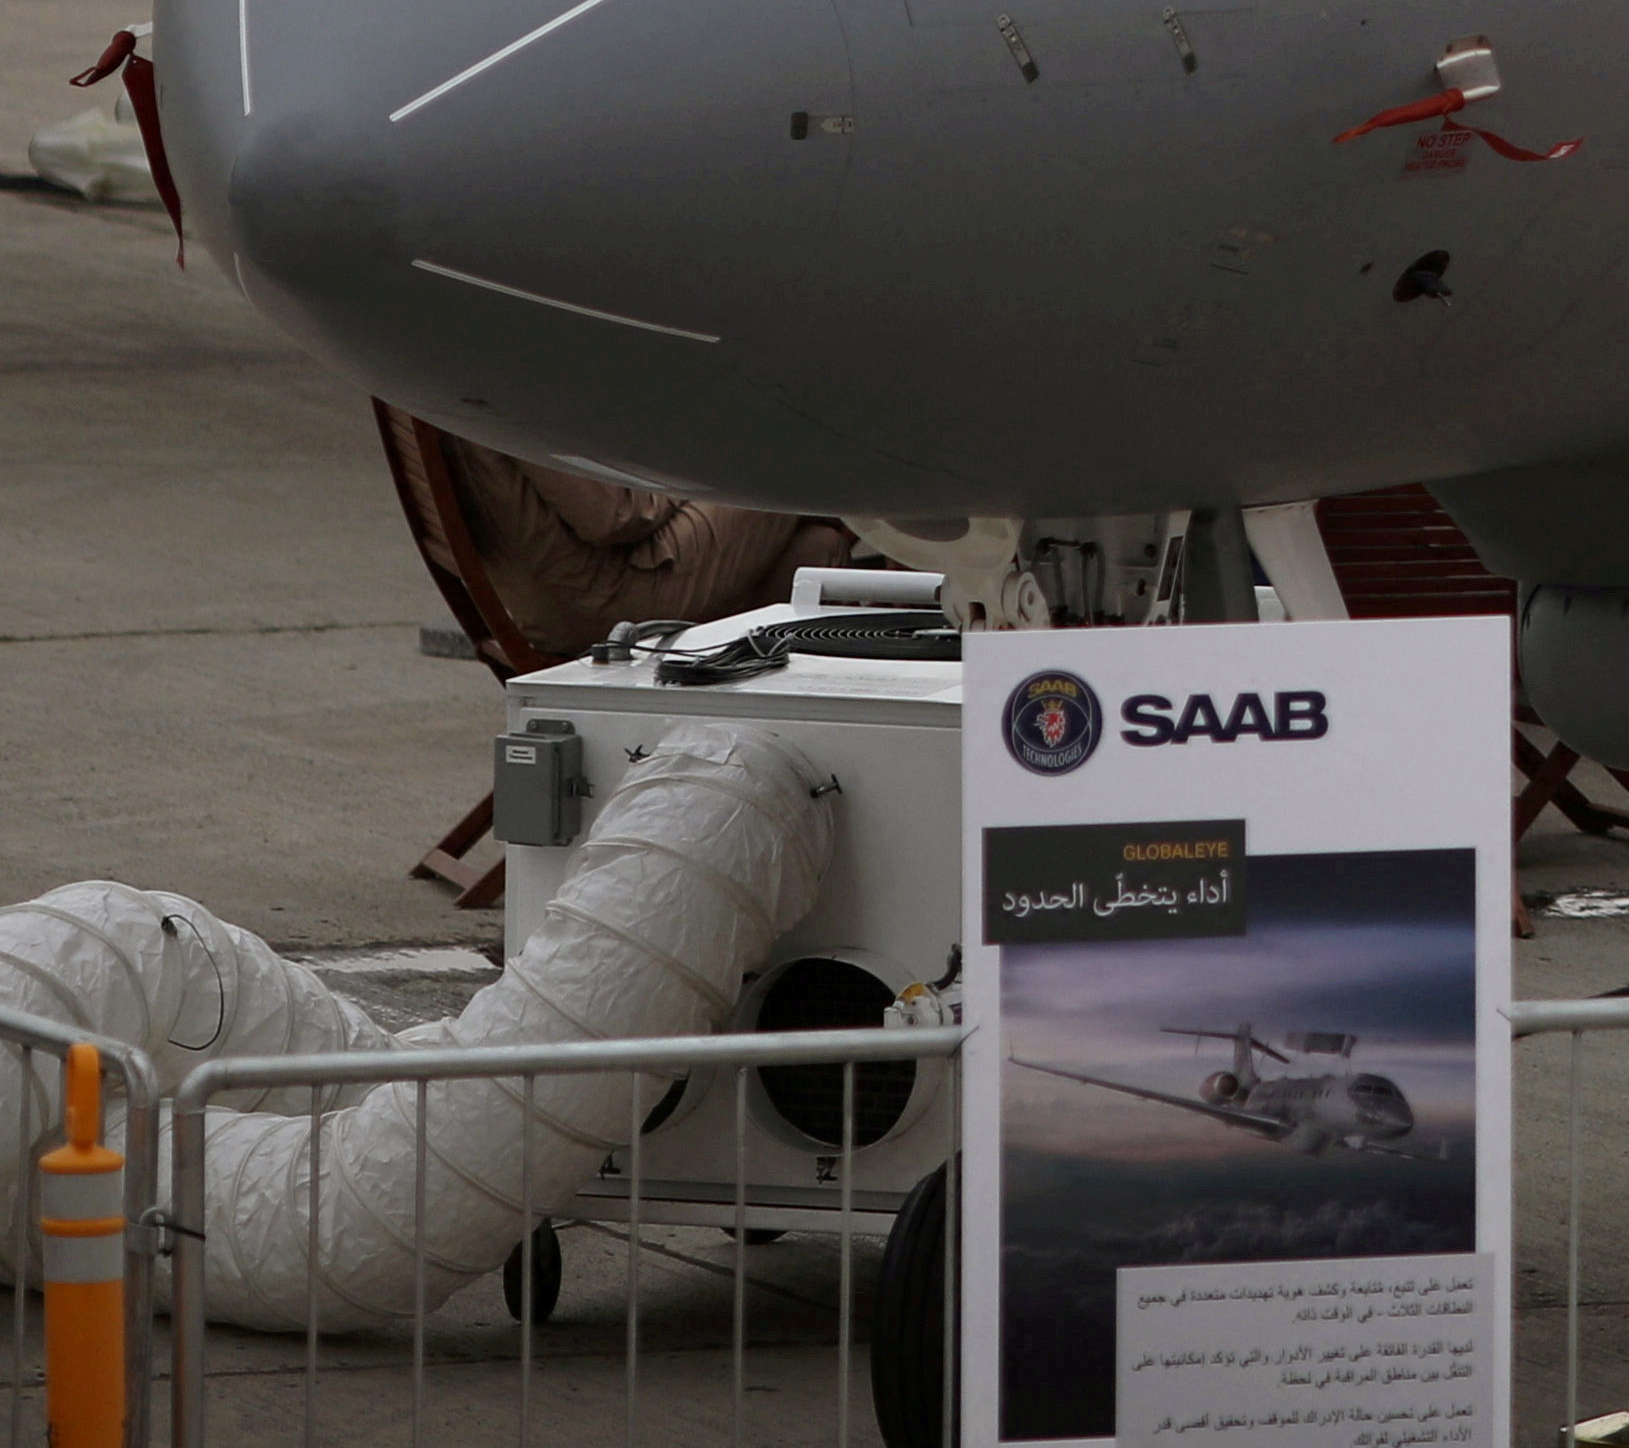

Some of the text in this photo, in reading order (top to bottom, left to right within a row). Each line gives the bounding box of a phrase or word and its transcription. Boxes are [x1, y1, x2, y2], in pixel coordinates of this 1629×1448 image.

[1416, 132, 1472, 150] NO STEP
[1027, 679, 1078, 700] SAAB
[1120, 690, 1330, 747] SAAB
[1021, 743, 1083, 768] TECHNOLOGIES
[1122, 841, 1230, 861] GLOBALEYE
[1186, 868, 1231, 904] أداء
[1001, 882, 1085, 918] الحدود
